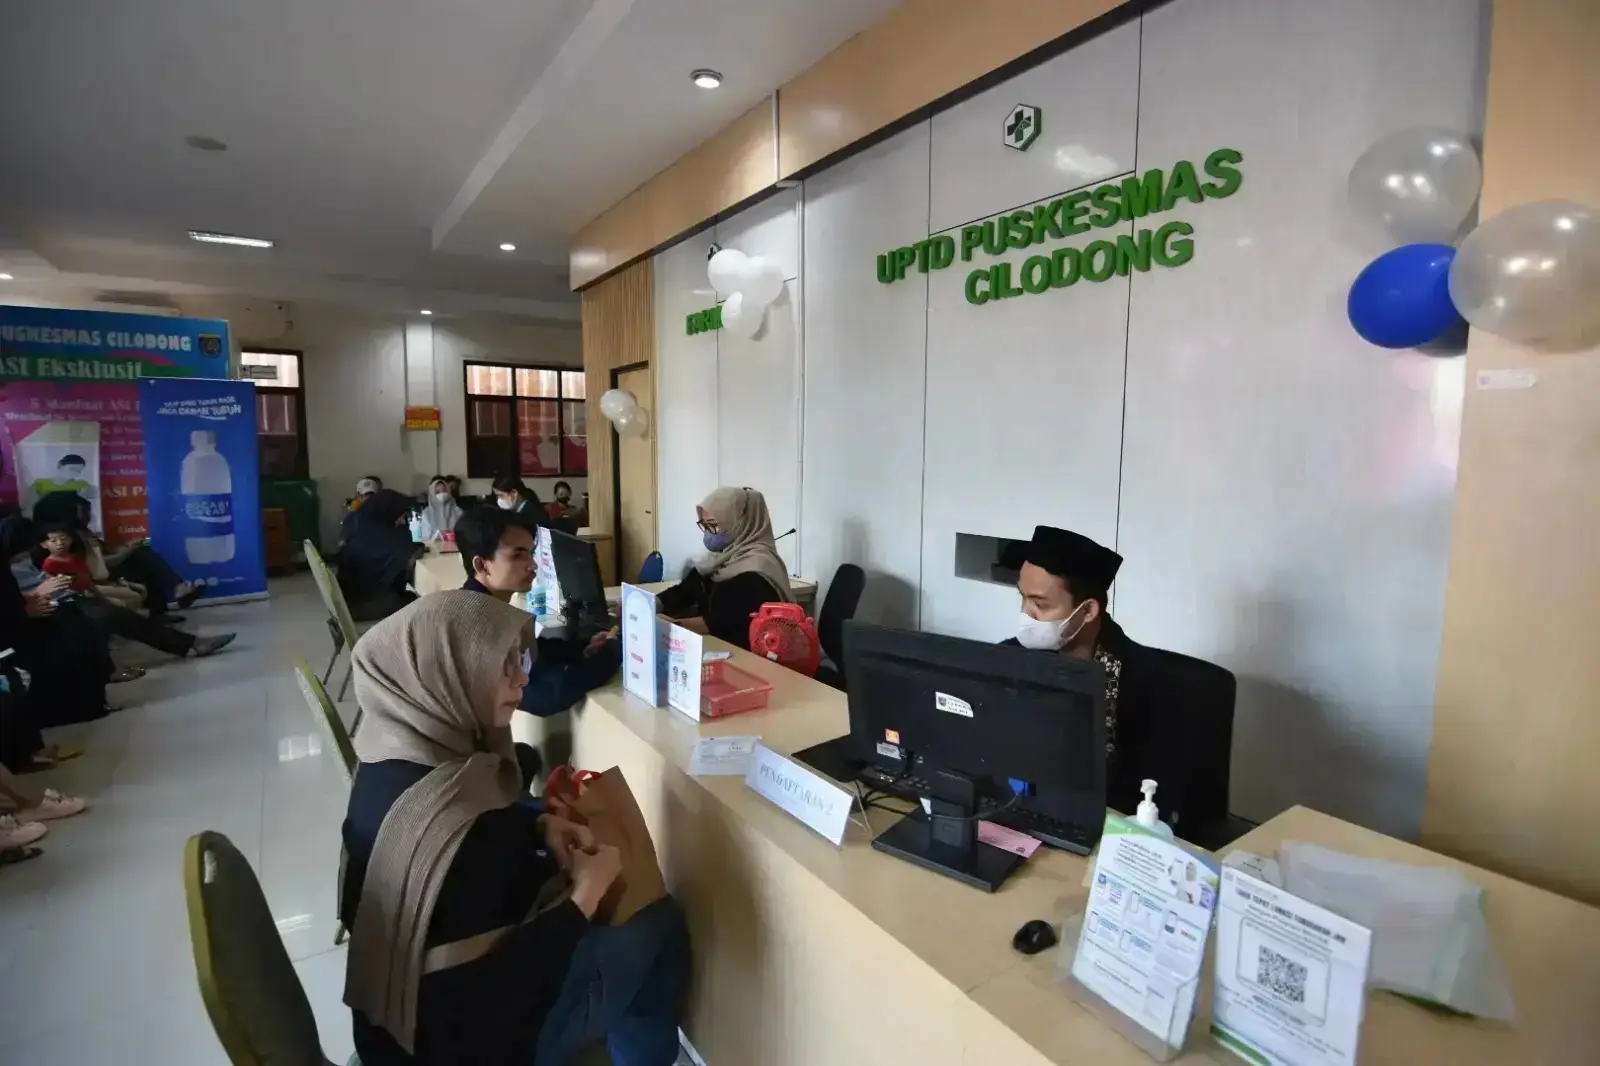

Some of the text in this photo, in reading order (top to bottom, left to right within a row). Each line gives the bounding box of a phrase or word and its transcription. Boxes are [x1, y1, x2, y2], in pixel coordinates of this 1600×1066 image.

[876, 148, 1243, 284] UPTD PUSKESMAS
[964, 220, 1195, 305] CILODONG
[759, 762, 824, 812] PENDAFTARAN
